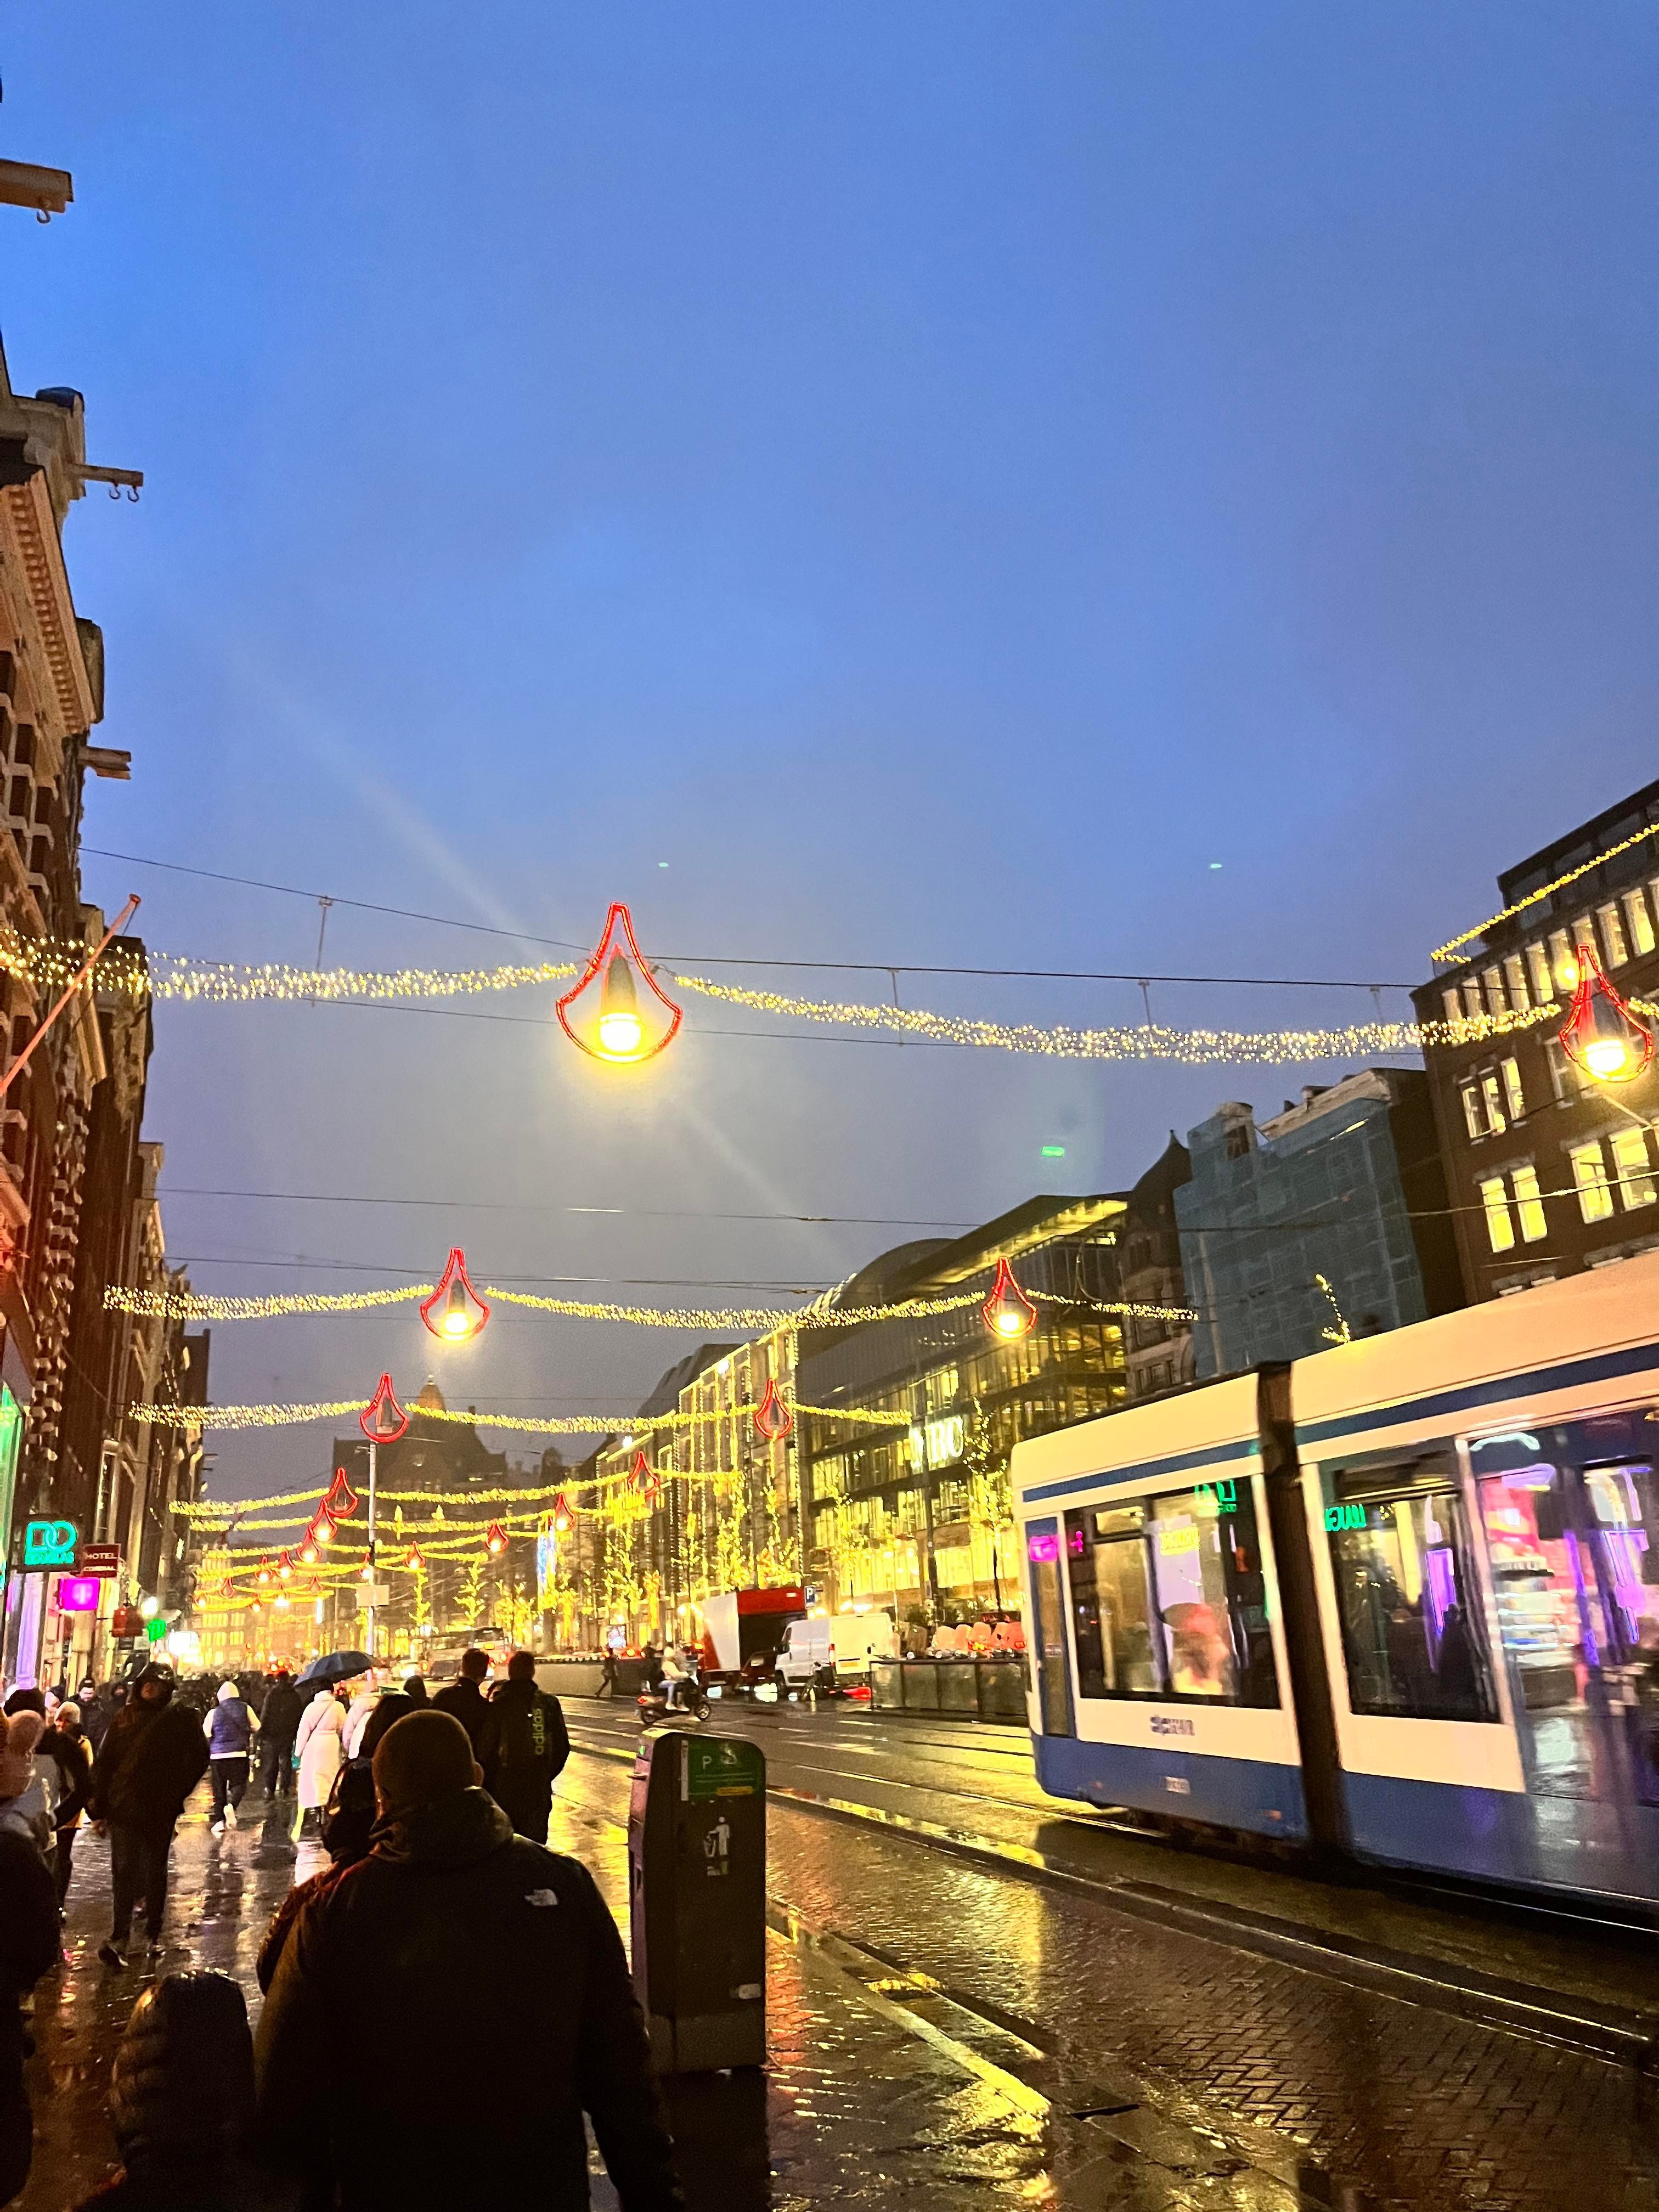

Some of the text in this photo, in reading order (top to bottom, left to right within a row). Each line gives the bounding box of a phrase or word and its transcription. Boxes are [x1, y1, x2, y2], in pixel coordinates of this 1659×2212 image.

[806, 1587, 814, 1600] P
[532, 1708, 544, 1755] adidas
[702, 1756, 712, 1770] P
